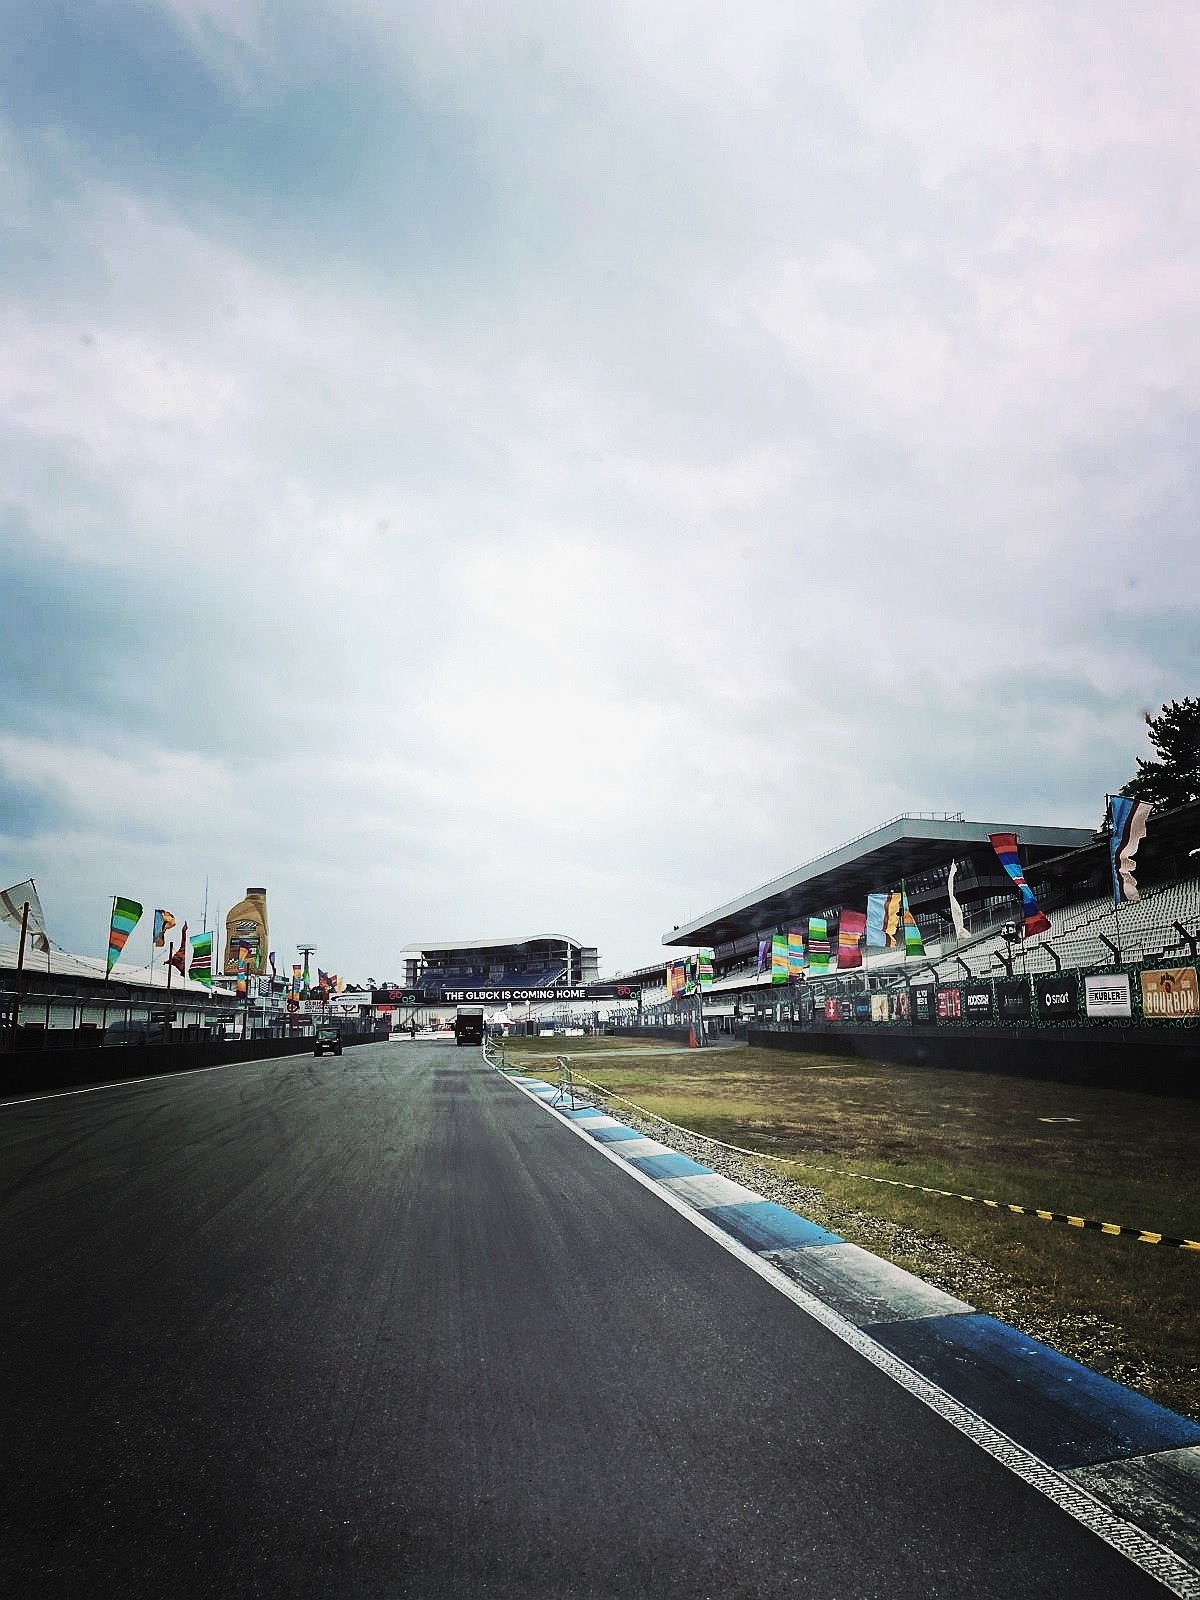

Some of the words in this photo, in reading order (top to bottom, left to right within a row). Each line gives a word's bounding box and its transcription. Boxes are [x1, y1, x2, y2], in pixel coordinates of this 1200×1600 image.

[444, 991, 464, 1001] THE
[501, 990, 511, 999] IS
[512, 990, 554, 999] COMING
[556, 989, 586, 998] HOME
[1052, 991, 1069, 1004] smart
[1147, 990, 1194, 1014] BOURBON
